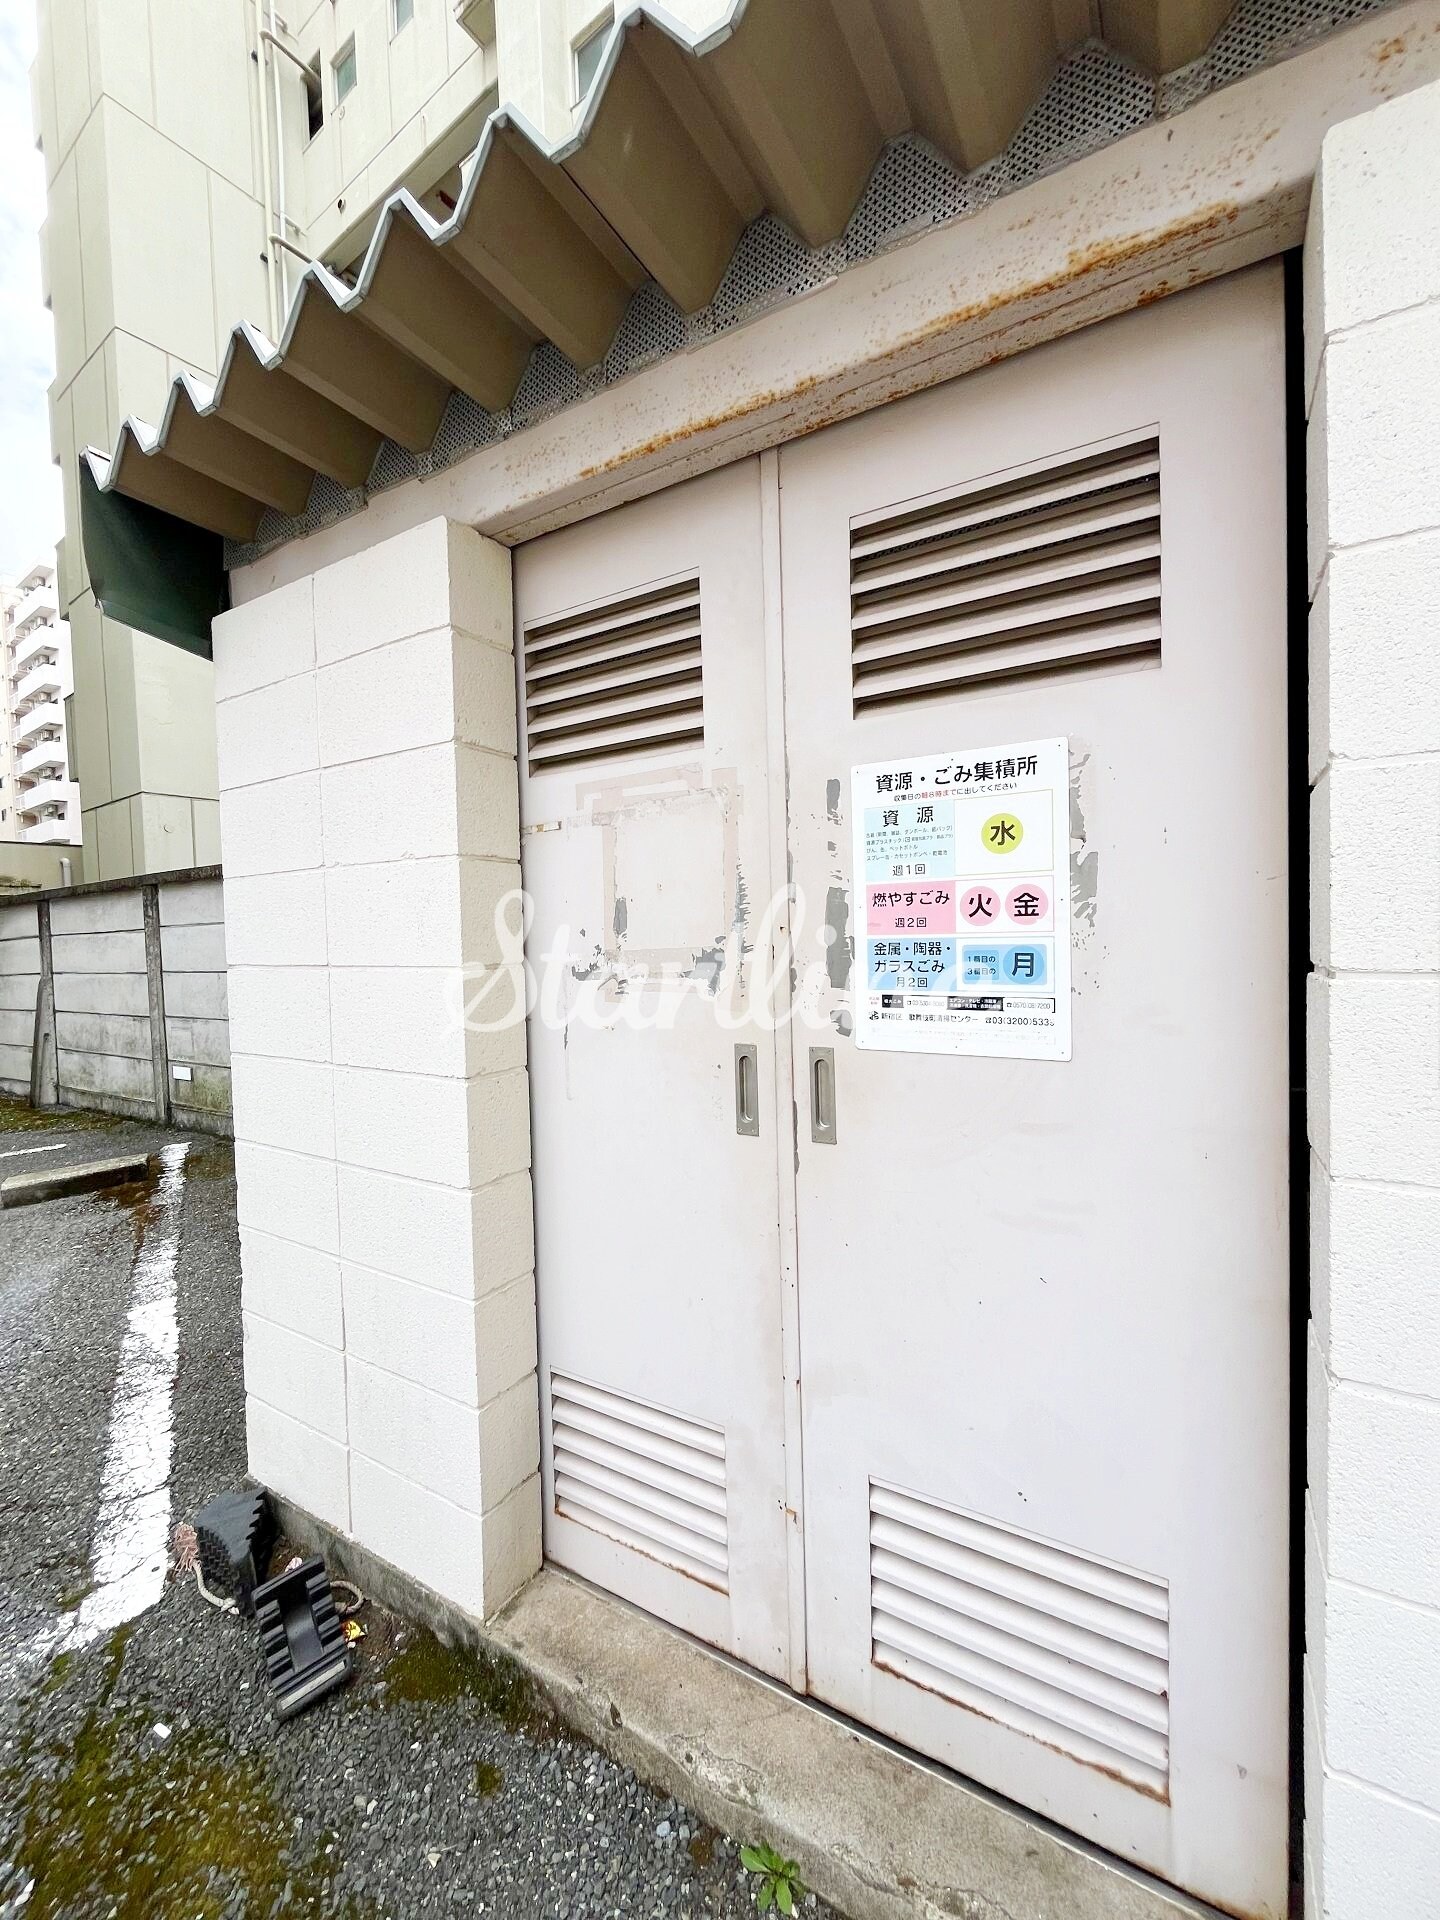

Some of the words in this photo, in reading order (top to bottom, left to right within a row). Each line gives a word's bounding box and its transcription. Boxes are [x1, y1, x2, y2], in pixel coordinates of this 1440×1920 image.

[876, 755, 1038, 793] 資源・ごみ集積所
[989, 820, 1016, 846] 水
[892, 863, 926, 877] 週1回
[872, 890, 950, 908] 燃やすごみ
[968, 893, 993, 918] 火
[1013, 892, 1040, 917] 金
[894, 917, 927, 929] 週2回
[873, 941, 951, 956] 金属・陶器・
[874, 959, 945, 974] ガラスごみ
[1011, 952, 1035, 978] 月
[896, 976, 928, 989] 月2回
